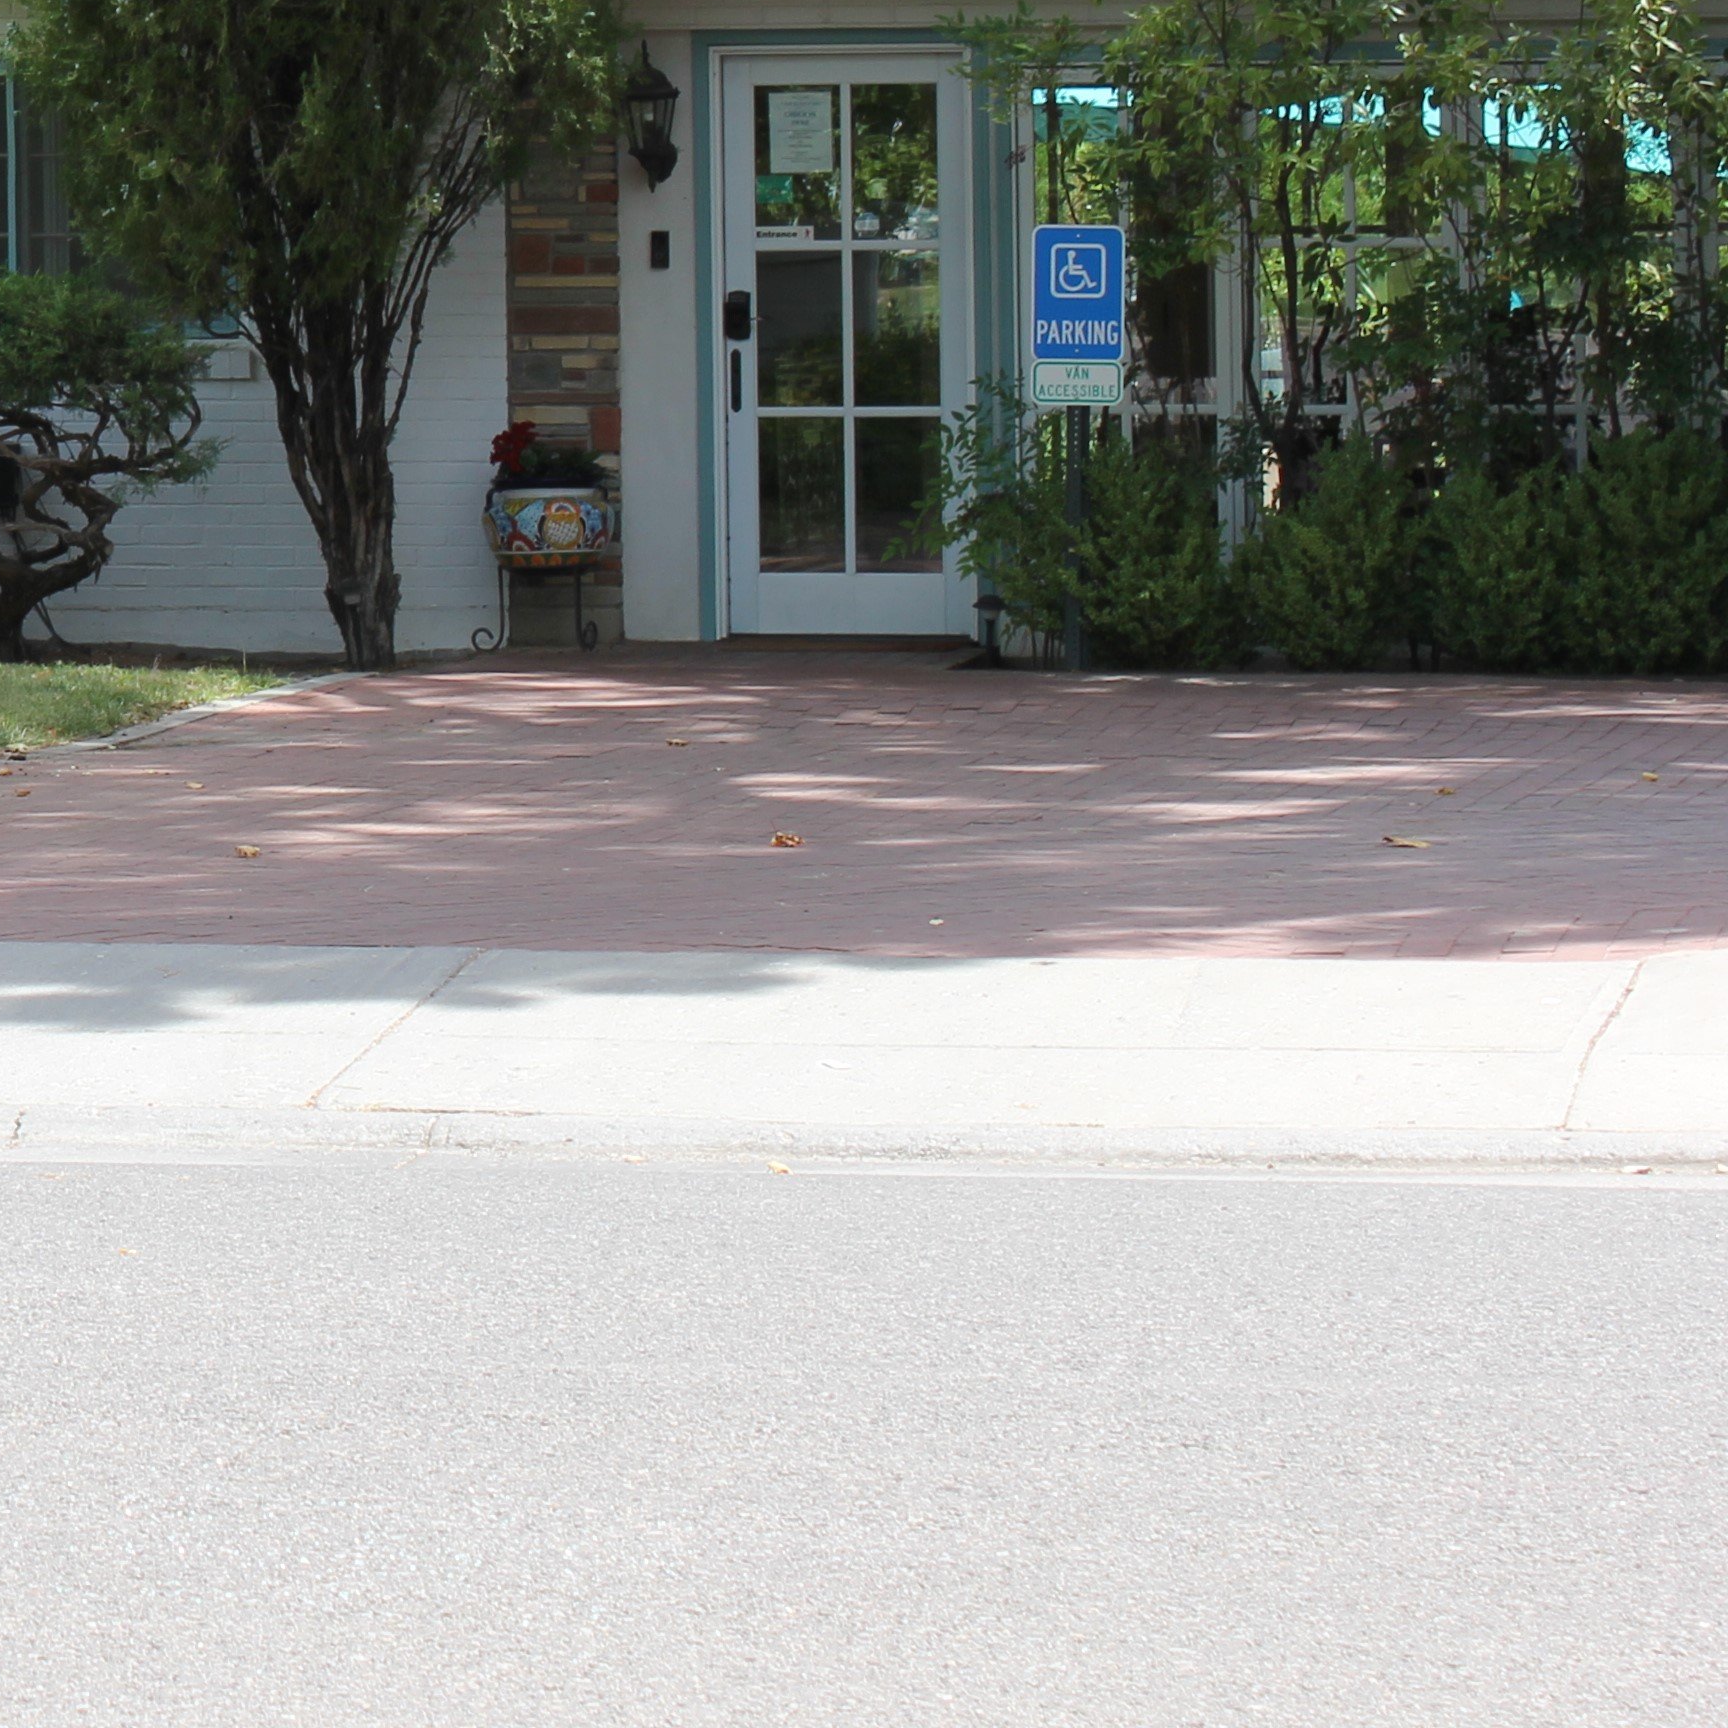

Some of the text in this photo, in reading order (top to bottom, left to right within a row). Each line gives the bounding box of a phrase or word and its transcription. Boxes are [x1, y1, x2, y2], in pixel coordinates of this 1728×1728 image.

[756, 230, 798, 239] Entrance
[1037, 319, 1119, 345] PARKING
[1065, 366, 1090, 380] VAN
[1038, 384, 1116, 398] ACCESSIBLE
